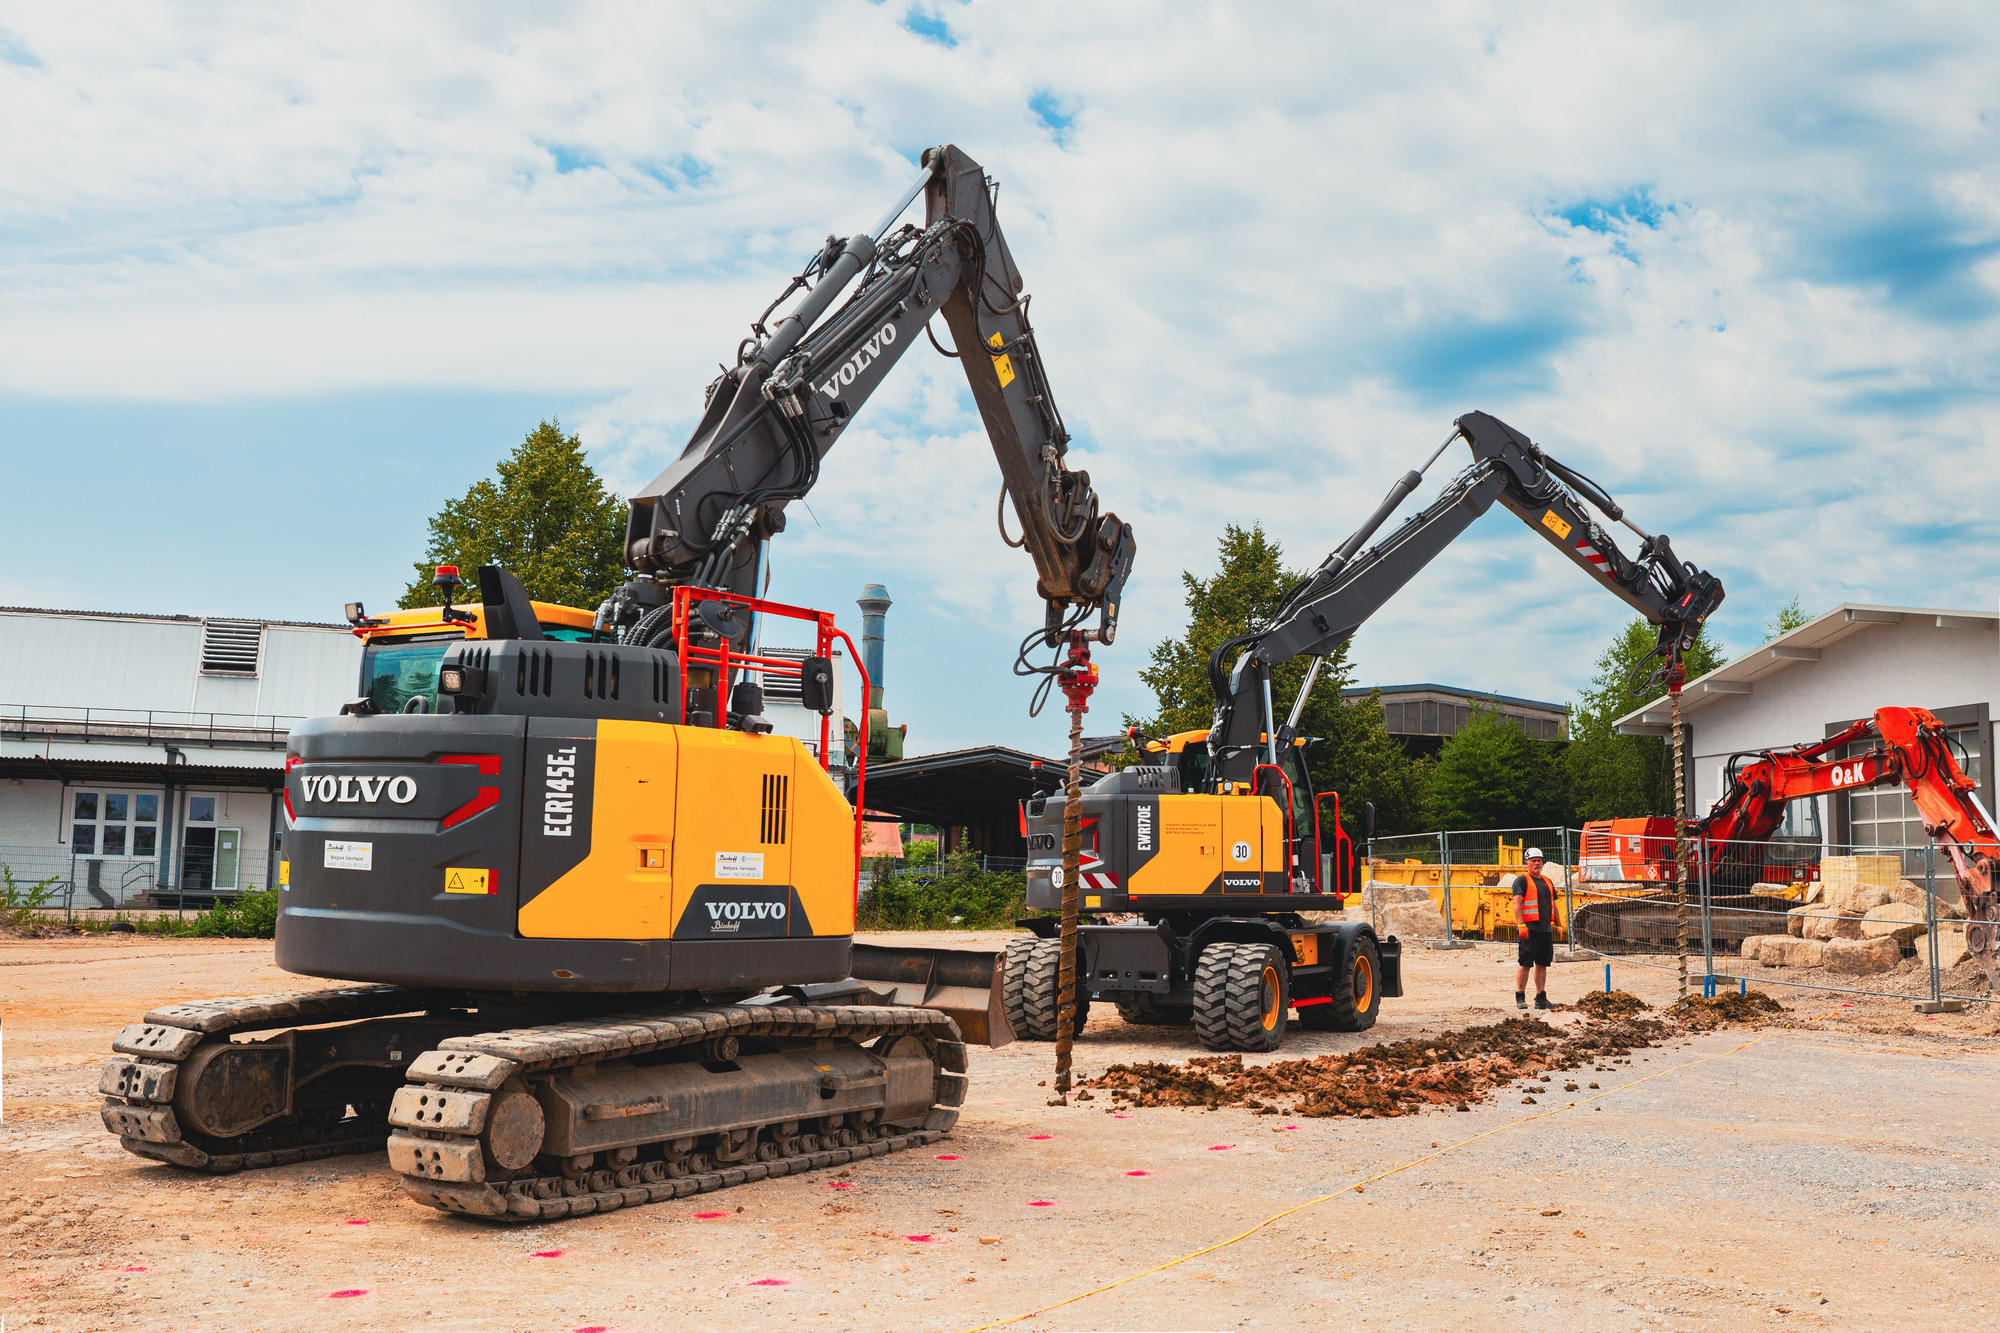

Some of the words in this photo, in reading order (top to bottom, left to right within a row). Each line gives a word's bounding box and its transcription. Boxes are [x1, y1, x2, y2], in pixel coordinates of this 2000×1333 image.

[819, 322, 898, 400] VOLVO
[1831, 762, 1866, 786] O&K
[300, 775, 418, 804] VOLVO
[1137, 805, 1151, 851] EWR170E
[1235, 845, 1248, 859] 30
[704, 902, 787, 920] VOLVO
[710, 920, 741, 933] Bischoff
